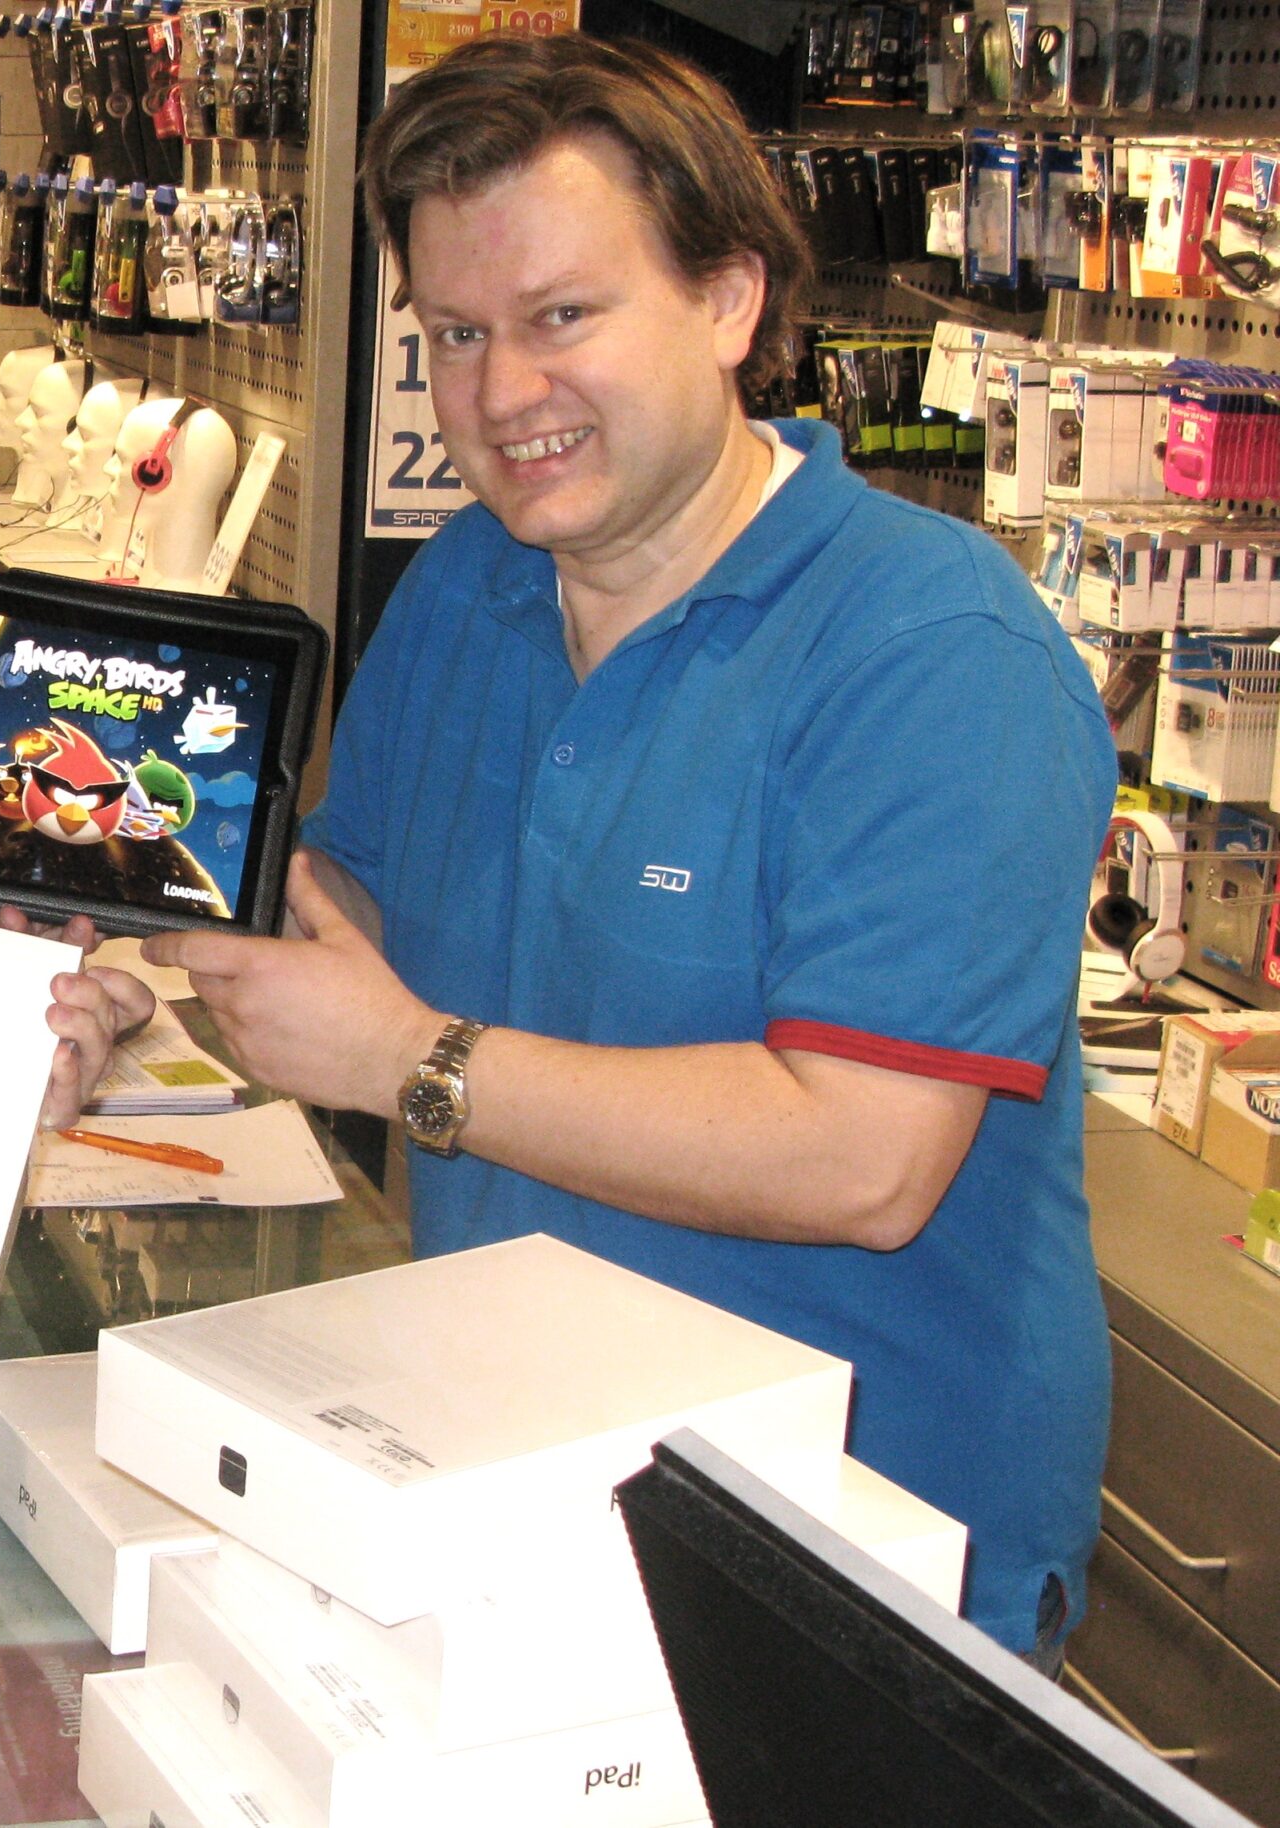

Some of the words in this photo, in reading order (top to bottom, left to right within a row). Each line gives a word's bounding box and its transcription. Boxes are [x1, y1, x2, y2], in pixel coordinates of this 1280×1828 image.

[449, 24, 474, 37] 2100
[393, 512, 455, 525] SPAC
[10, 639, 102, 685] ANGRY
[102, 657, 186, 707] BIRDS
[48, 680, 141, 721] SPACE
[142, 695, 164, 712] HD
[18, 1484, 37, 1522] iPad
[584, 1762, 642, 1796] iPad
